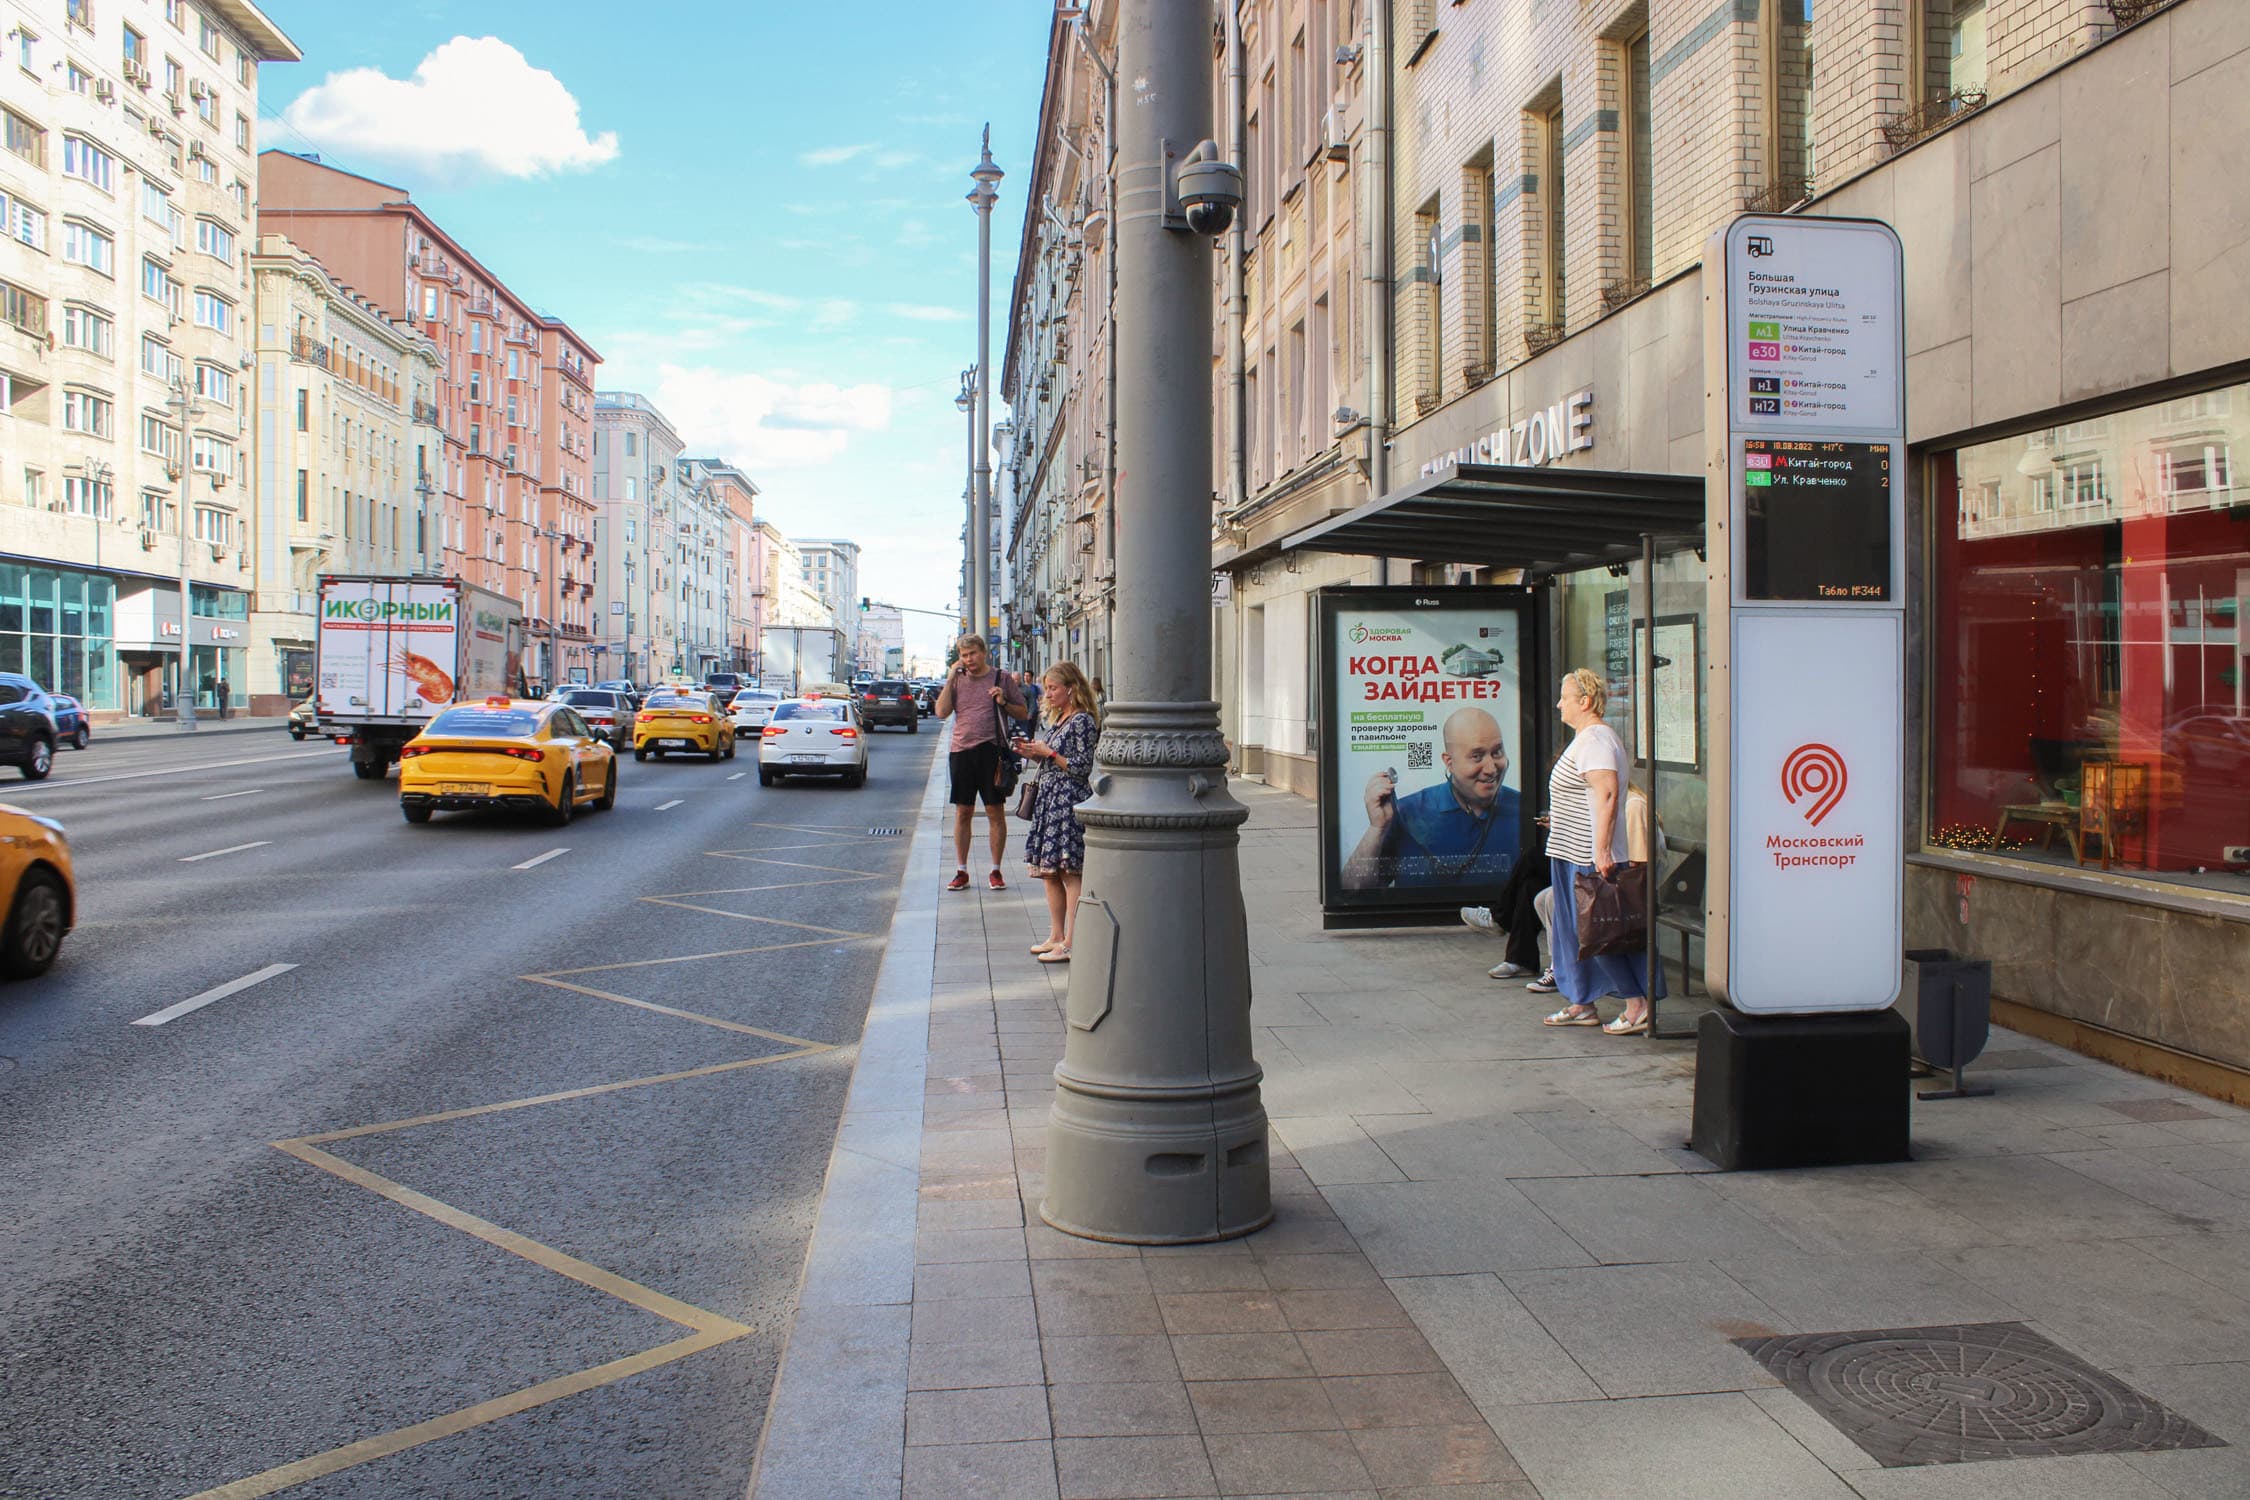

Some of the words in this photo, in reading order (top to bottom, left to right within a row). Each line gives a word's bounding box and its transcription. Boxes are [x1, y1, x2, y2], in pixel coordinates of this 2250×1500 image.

[1748, 271, 1795, 282] Большая
[1748, 283, 1807, 295] Грузинская
[1809, 287, 1840, 297] улица
[1748, 298, 1780, 307] Bolshaya
[1781, 299, 1824, 309] Gruzinskaya
[1783, 325, 1807, 333] Улица
[1808, 326, 1850, 335] Кравченко
[1798, 346, 1847, 355] Китай-город
[1798, 381, 1847, 390] Китай-город
[1798, 401, 1847, 410] Китай-город
[1512, 392, 1593, 468] ZONE
[1788, 457, 1853, 470] Китай-город
[1881, 461, 1888, 470] 0
[1773, 475, 1789, 485] Ул.
[1792, 475, 1847, 487] Кравченко
[1881, 477, 1888, 487] 2
[1818, 586, 1848, 596] Табло
[326, 598, 452, 621] ИКОРНЫЙ
[1350, 656, 1440, 678] КОГДА
[1364, 675, 1501, 703] ЗАЙДЕТЕ?
[1366, 713, 1421, 722] бесплатную
[1351, 724, 1394, 733] проверку
[1396, 723, 1438, 732] здоровья
[1766, 834, 1864, 849] Московский
[1773, 852, 1856, 870] Транспорт
